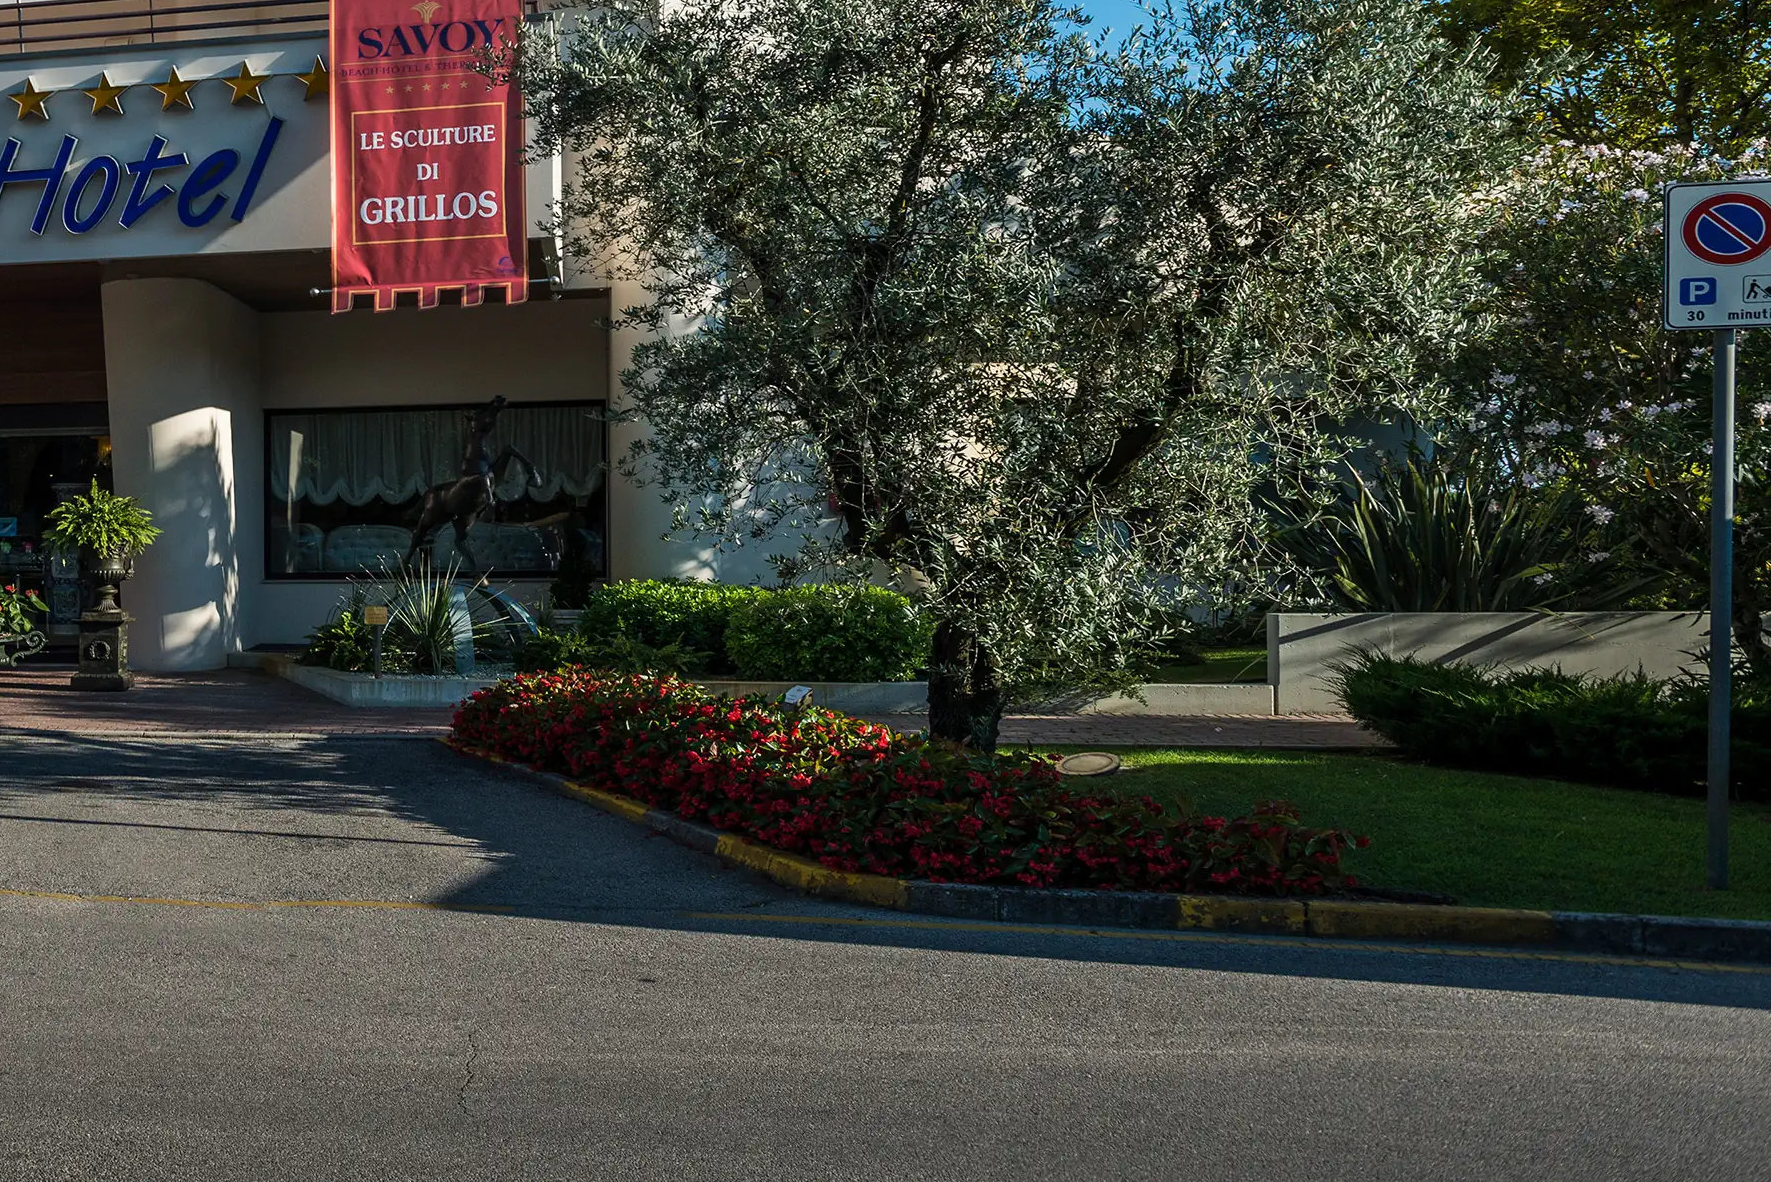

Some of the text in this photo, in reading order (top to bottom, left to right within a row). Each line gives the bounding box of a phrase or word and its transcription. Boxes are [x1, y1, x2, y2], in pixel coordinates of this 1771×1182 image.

[358, 18, 505, 59] SAVOY
[340, 66, 379, 77] BEACH
[382, 64, 421, 75] HOTEL
[360, 124, 496, 151] LE SCULTURE
[416, 162, 439, 182] DI
[359, 189, 499, 227] GRILLOS
[1689, 281, 1710, 302] P
[1687, 310, 1705, 321] 30
